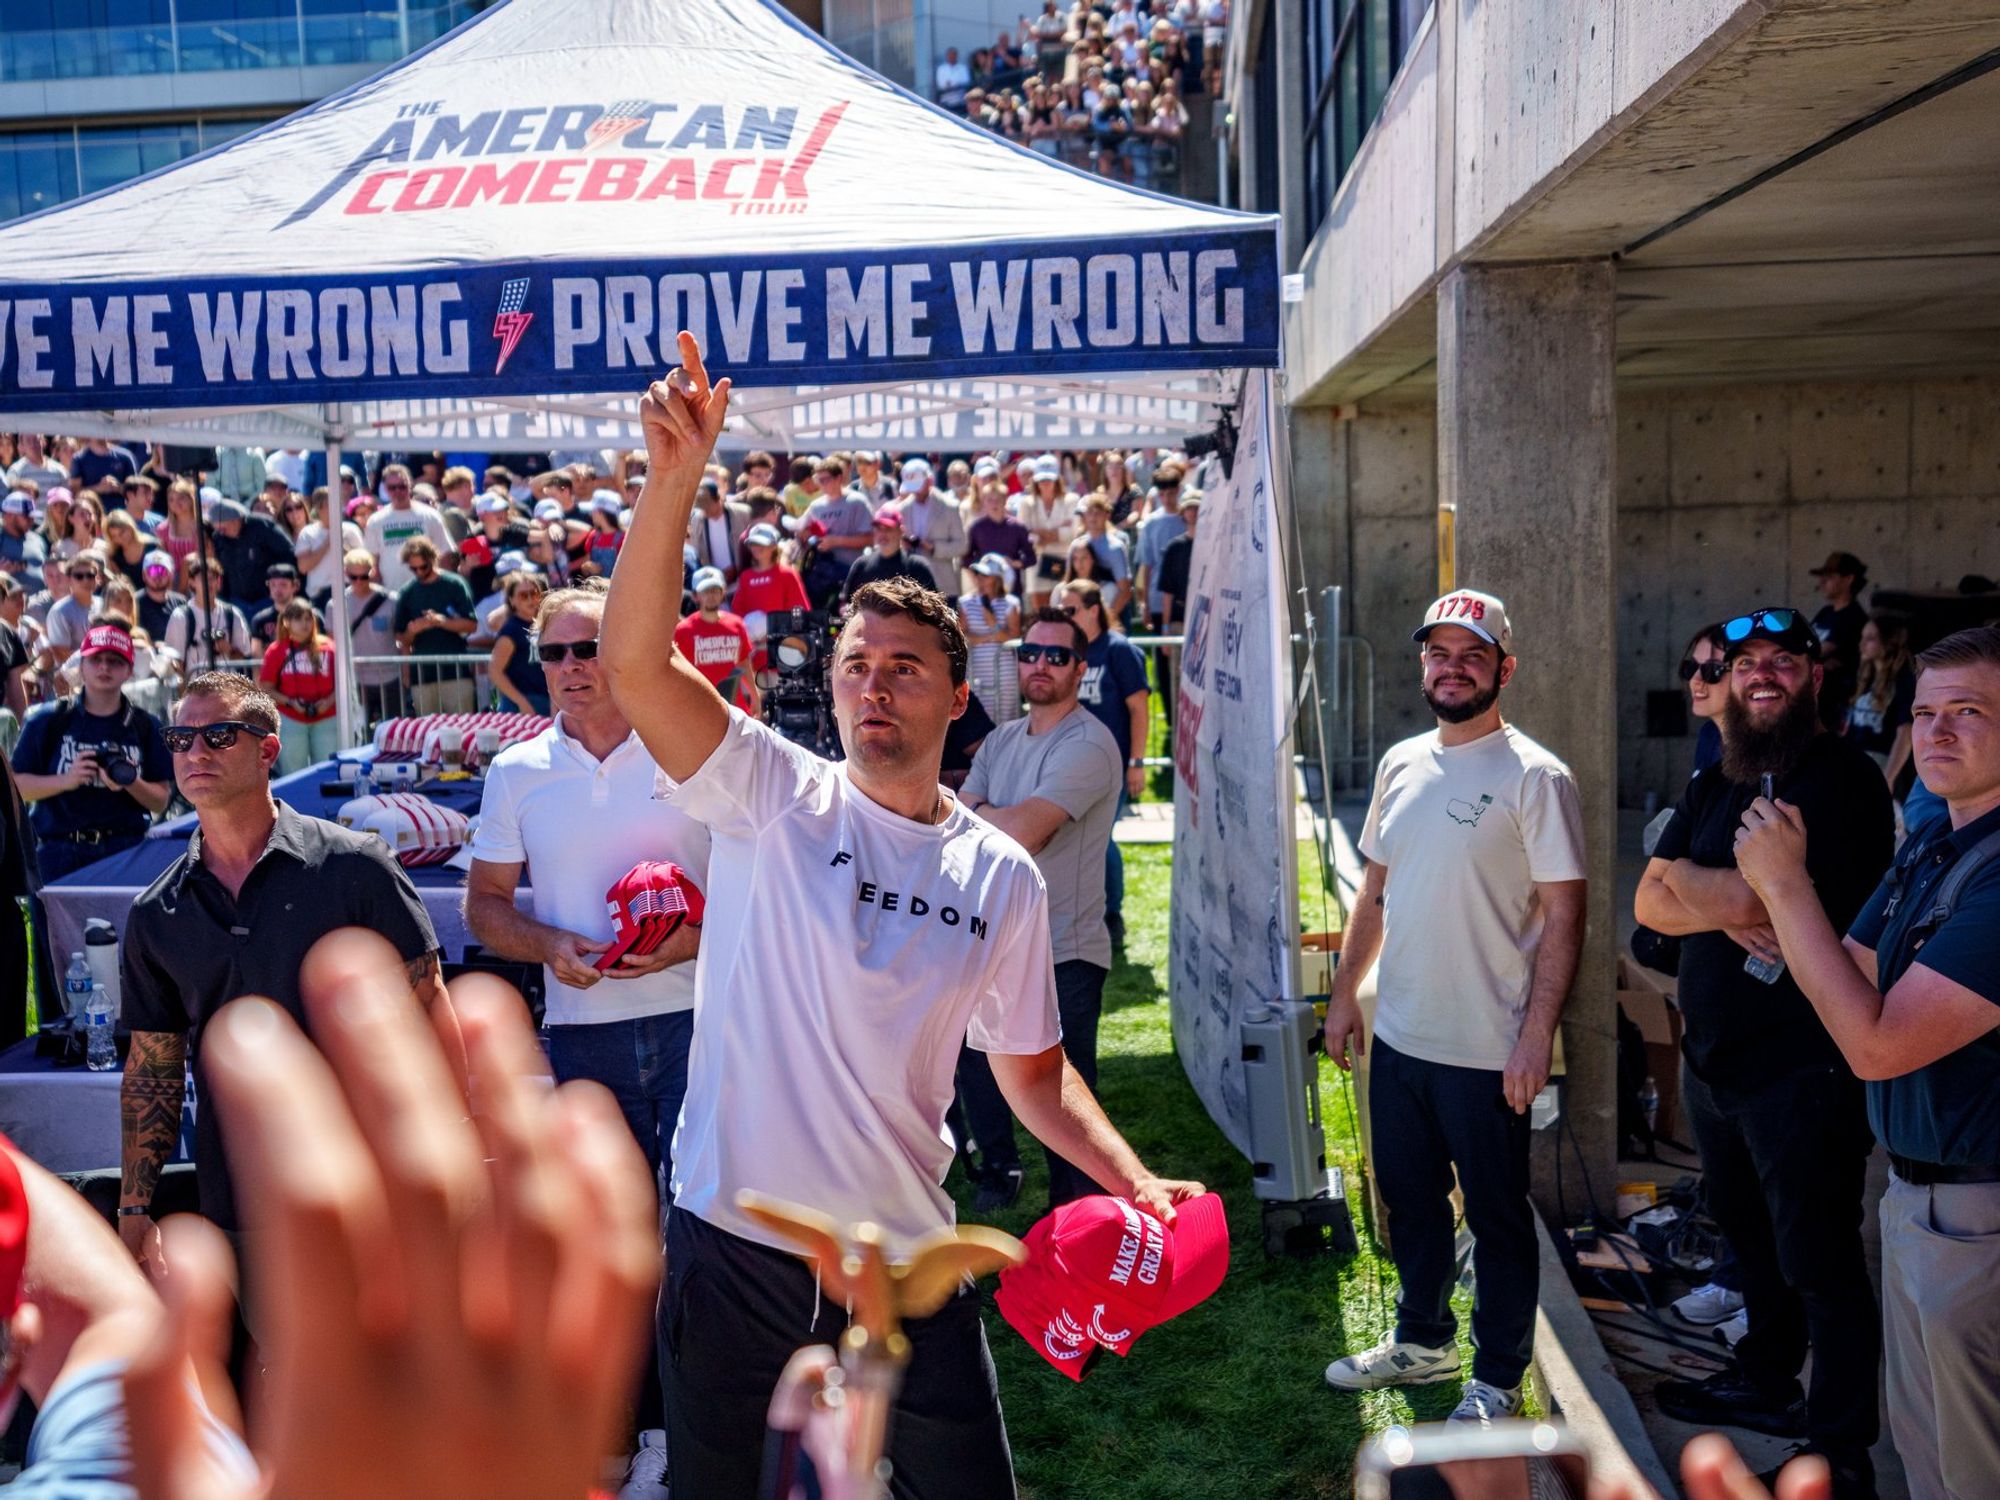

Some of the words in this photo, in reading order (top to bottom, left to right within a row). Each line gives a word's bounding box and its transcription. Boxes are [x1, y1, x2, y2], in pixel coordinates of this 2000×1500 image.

[399, 100, 443, 118] THE
[344, 100, 851, 216] COMEBACK
[730, 201, 808, 216] TOUR
[0, 298, 55, 388] E
[71, 293, 173, 388] ME
[189, 282, 470, 383] WRONG
[553, 269, 807, 370] PROVE
[826, 263, 932, 360] ME
[950, 249, 1244, 352] WRONG
[830, 851, 988, 941] FEEDOM
[1109, 1234, 1140, 1286] MAKE
[1137, 1231, 1164, 1285] GREAT
